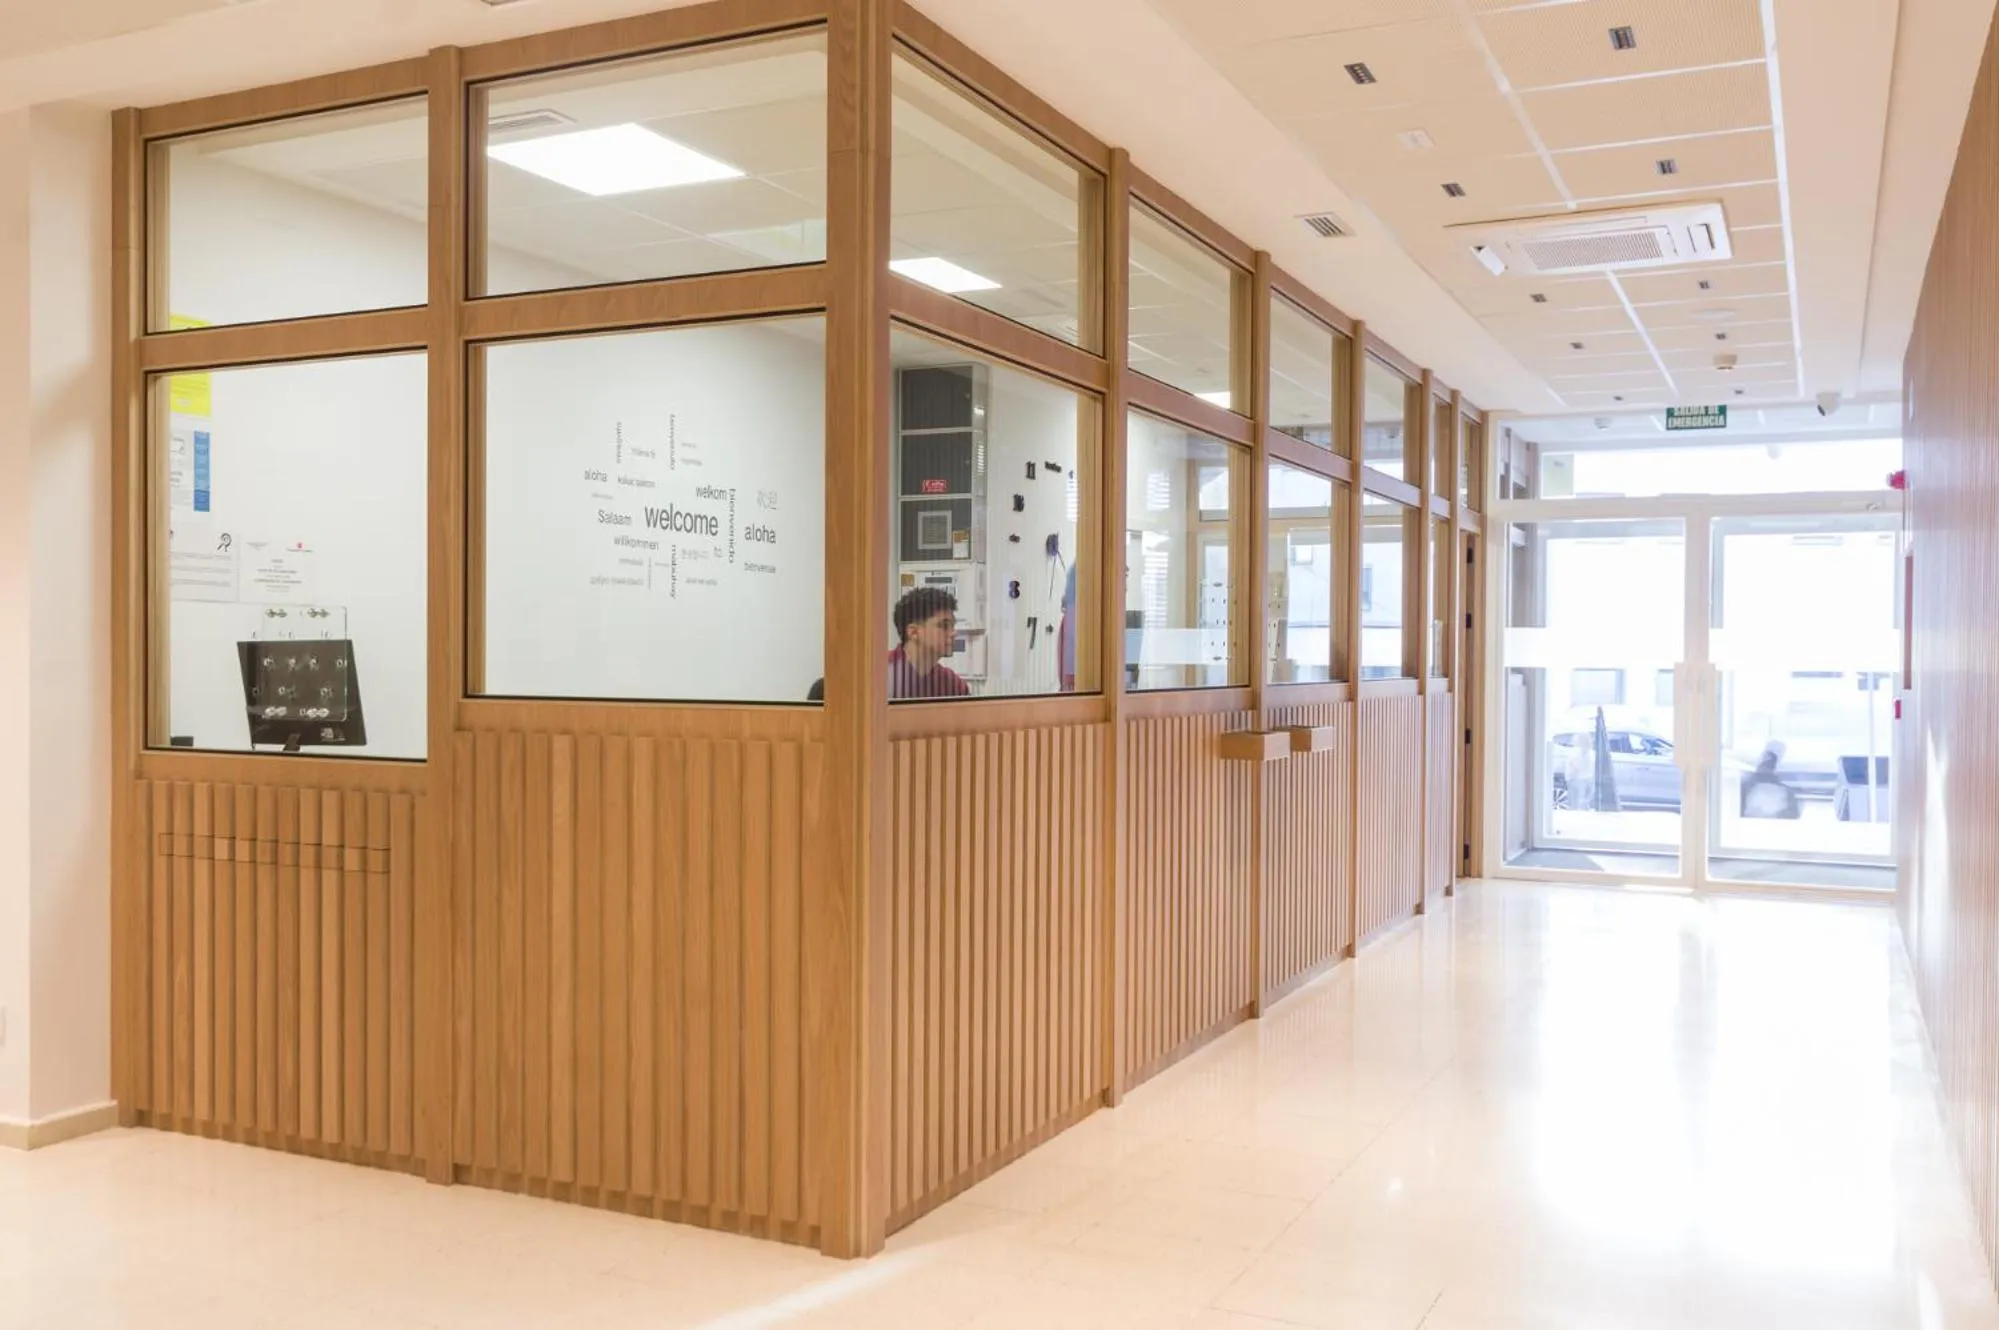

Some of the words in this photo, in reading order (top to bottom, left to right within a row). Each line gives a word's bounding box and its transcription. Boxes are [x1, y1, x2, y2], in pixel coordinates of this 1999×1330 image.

[695, 484, 727, 500] welkom
[597, 509, 632, 526] Salaam
[645, 503, 719, 537] welcome
[613, 535, 659, 551] willkommen
[744, 523, 777, 544] aloha
[1009, 580, 1021, 599] 8
[1027, 617, 1037, 650] 7
